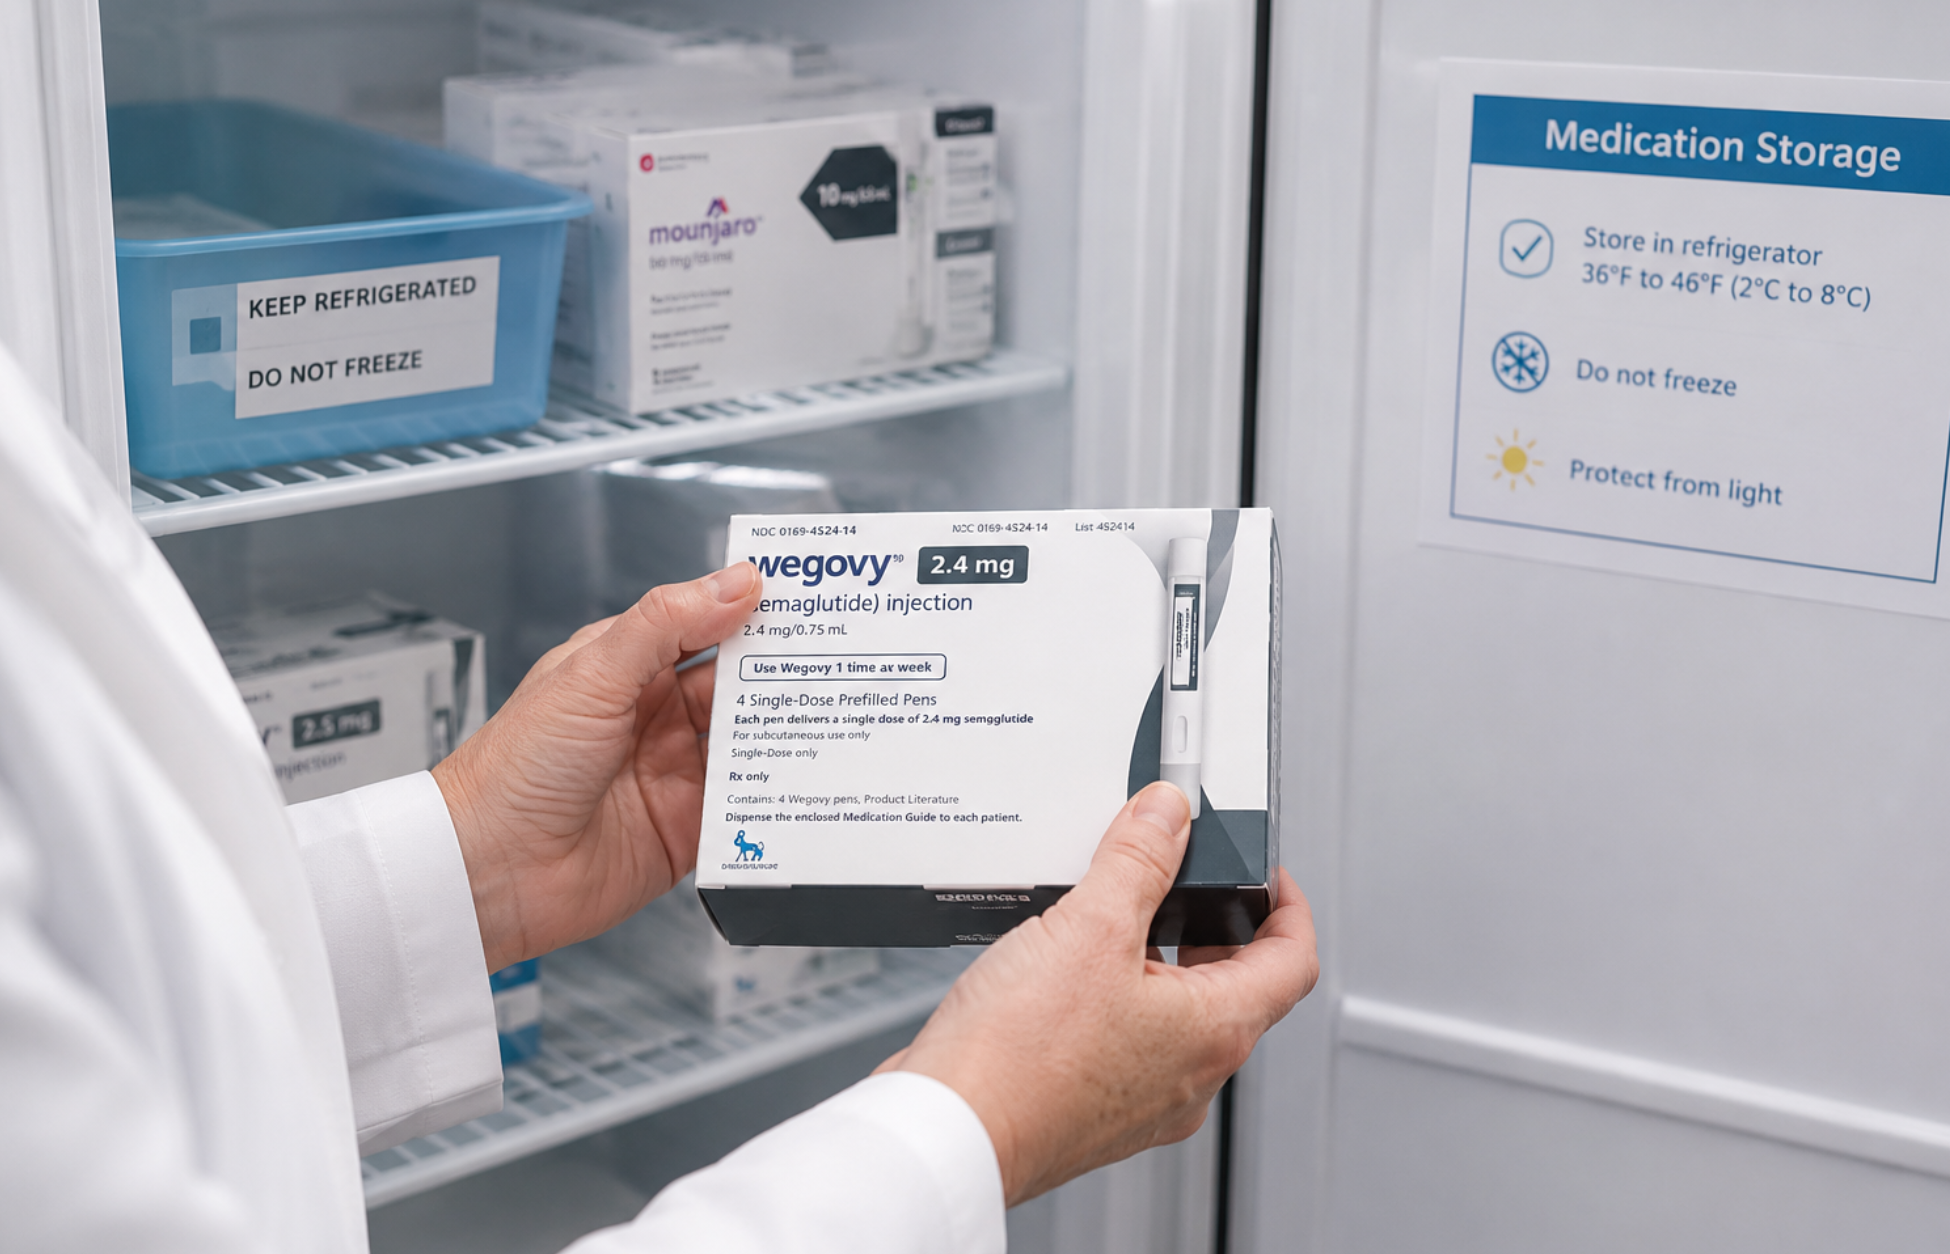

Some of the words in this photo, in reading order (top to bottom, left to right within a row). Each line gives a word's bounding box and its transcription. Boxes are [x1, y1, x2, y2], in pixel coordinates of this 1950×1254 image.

[1545, 119, 1744, 162] Medication
[1756, 131, 1901, 177] Storage
[649, 217, 758, 246] mounjaro
[1583, 226, 1646, 252] Store
[1653, 232, 1674, 254] in
[1682, 235, 1823, 266] refrigerator
[249, 294, 307, 319] KEEP
[315, 276, 477, 312] REFRIGERATED
[1581, 262, 1632, 287] 36°F
[1640, 270, 1664, 290] to
[1670, 271, 1724, 295] 46°F
[1730, 275, 1781, 302] (2°C
[1788, 282, 1813, 303] to
[1820, 284, 1871, 312] 8°C)
[248, 368, 282, 389] DO
[290, 360, 338, 384] NOT
[345, 350, 423, 377] FREEZE
[1576, 358, 1610, 383] Do
[1616, 368, 1656, 388] not
[1664, 368, 1738, 397] freeze
[1570, 459, 1656, 490] Protect
[1664, 470, 1721, 498] from
[1728, 479, 1783, 507] light
[930, 555, 969, 574] 2.4
[975, 558, 1015, 579] mg
[753, 593, 879, 618] emaglutide)
[886, 592, 973, 616] injection
[743, 624, 765, 636] 2.4
[769, 624, 825, 640] mg/0.75
[828, 623, 848, 636] mL
[753, 662, 777, 674] Use
[781, 662, 832, 677] Wegovy
[836, 662, 843, 674] 1
[847, 661, 876, 674] time
[898, 661, 932, 673] week
[736, 694, 746, 707] 4
[750, 693, 835, 710] Single-Dose
[838, 692, 899, 707] Prefilled
[903, 694, 937, 707] Pens
[734, 714, 760, 725] Each
[763, 716, 785, 727] pen
[787, 714, 830, 725] delivers
[832, 716, 840, 725] a
[842, 714, 876, 727] single
[878, 713, 905, 725] dose
[908, 713, 921, 724] of
[922, 714, 940, 724] 2.4
[942, 715, 962, 727] mg
[732, 730, 750, 741] For
[753, 730, 826, 741] subcutaneous
[827, 732, 846, 740] use
[848, 731, 872, 742] only
[731, 748, 793, 760] Single-Dose
[795, 747, 819, 760] only
[728, 772, 743, 782] Rx
[745, 771, 770, 784] only
[726, 794, 776, 805] Contains:
[778, 795, 786, 804] 4
[788, 794, 832, 807] Wegovy
[833, 795, 861, 807] pens,
[863, 794, 905, 805] Product
[908, 794, 960, 805] Literature
[725, 812, 773, 825] Dispense
[775, 812, 793, 822] the
[795, 812, 841, 822] enclosed
[843, 811, 903, 822] Medication
[905, 811, 937, 822] Guide
[939, 813, 951, 822] to
[953, 812, 979, 822] each
[981, 812, 1023, 825] patient.
